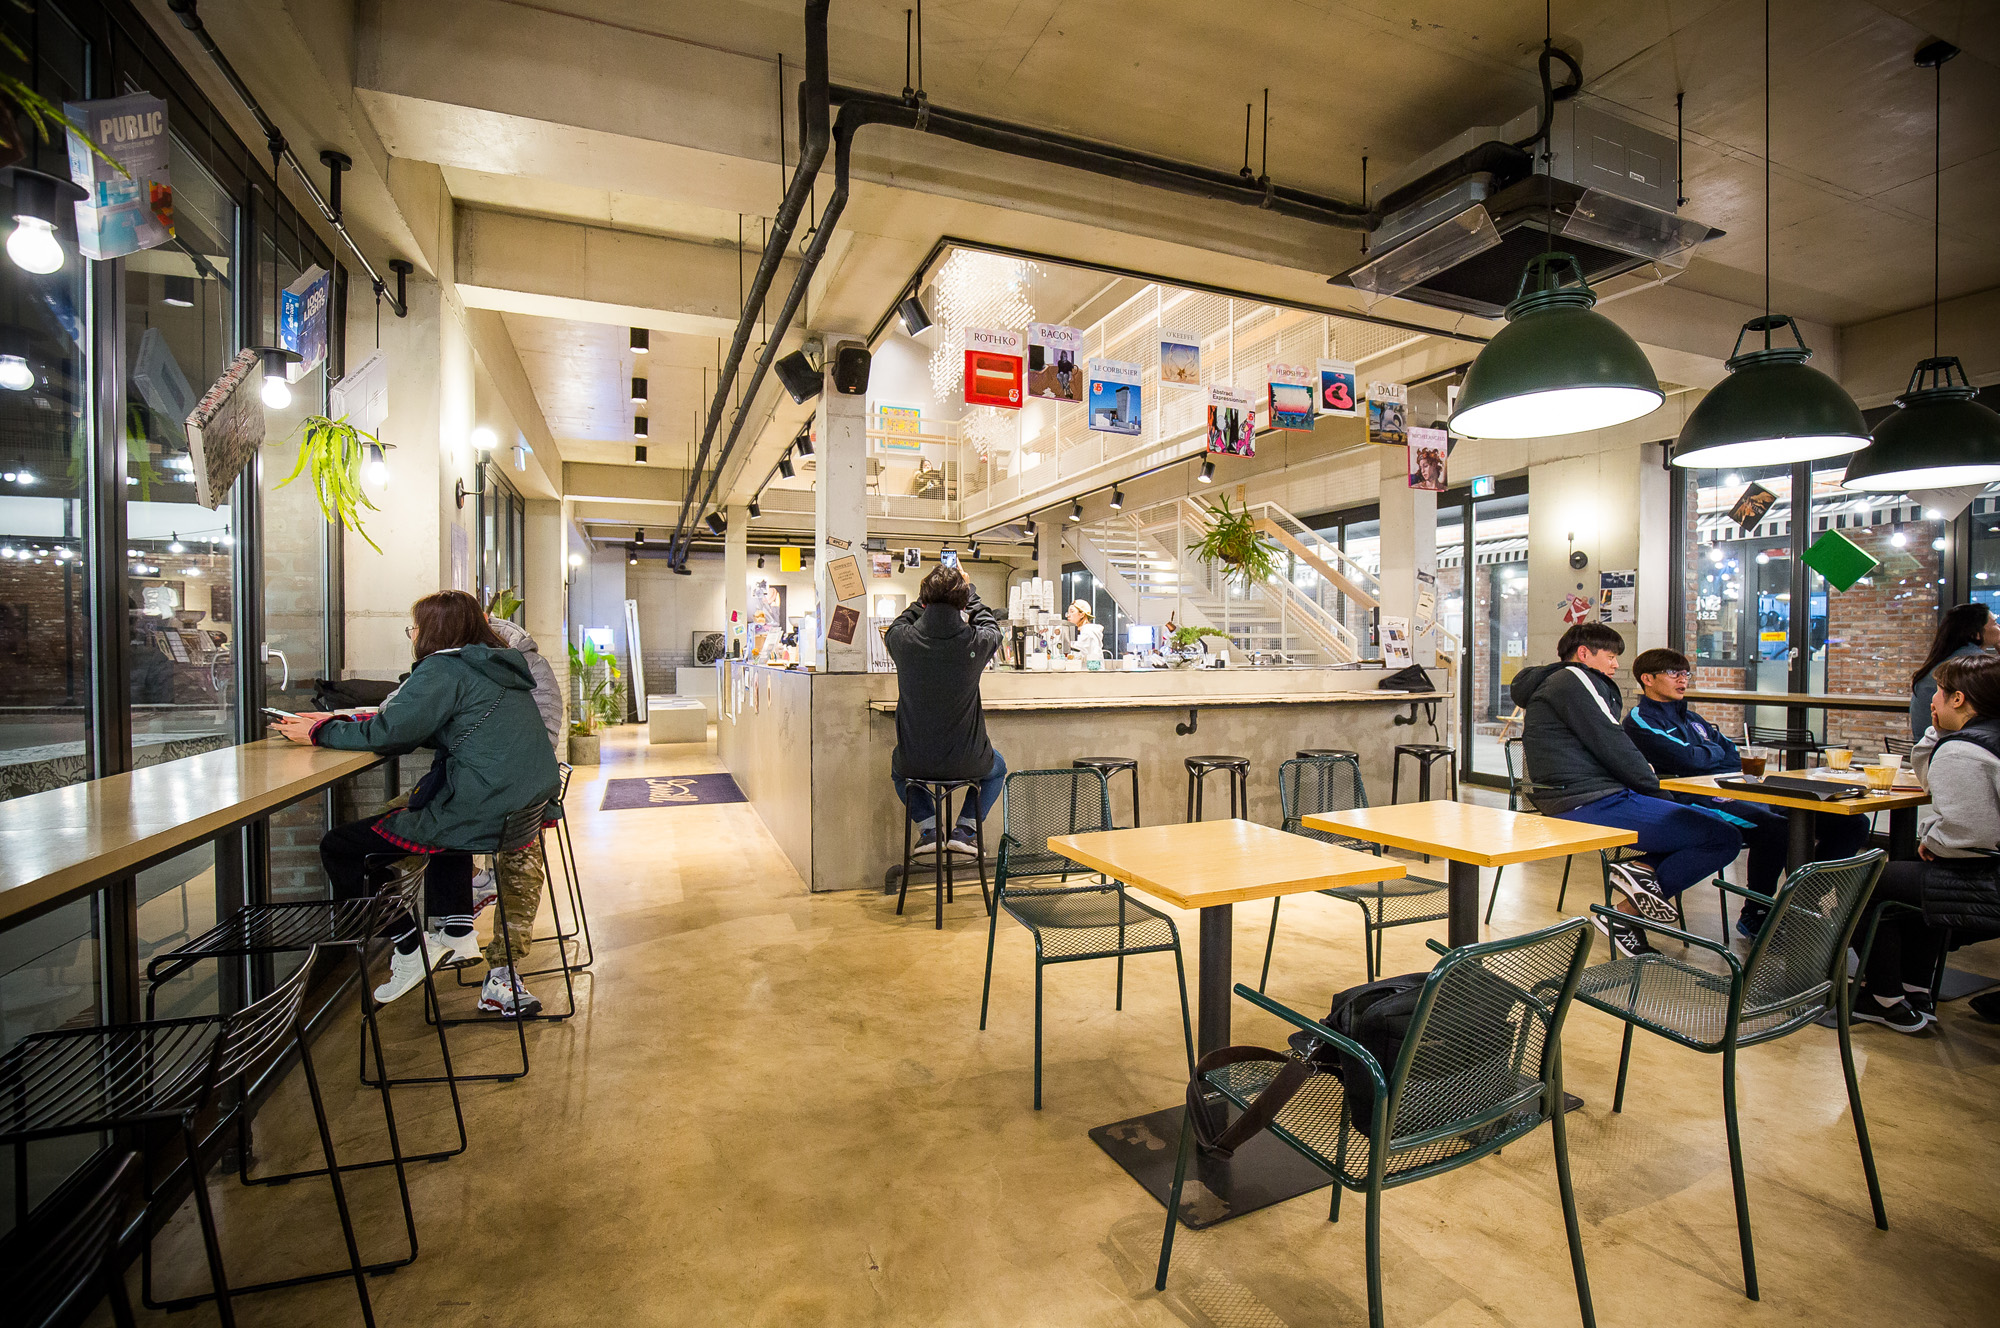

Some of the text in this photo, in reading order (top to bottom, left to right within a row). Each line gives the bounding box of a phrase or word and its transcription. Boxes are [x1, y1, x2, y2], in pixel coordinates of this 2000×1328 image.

[100, 111, 163, 144] PUBLIC
[307, 287, 324, 309] 1000
[303, 294, 326, 322] LIGHTS
[974, 332, 1016, 346] ROTHKO
[1041, 328, 1073, 341] BACON
[1166, 331, 1195, 341] O'KEEFFE
[1102, 366, 1138, 376] CORBUSIER
[1212, 388, 1234, 397] Abstract
[1212, 394, 1248, 404] Expressionism
